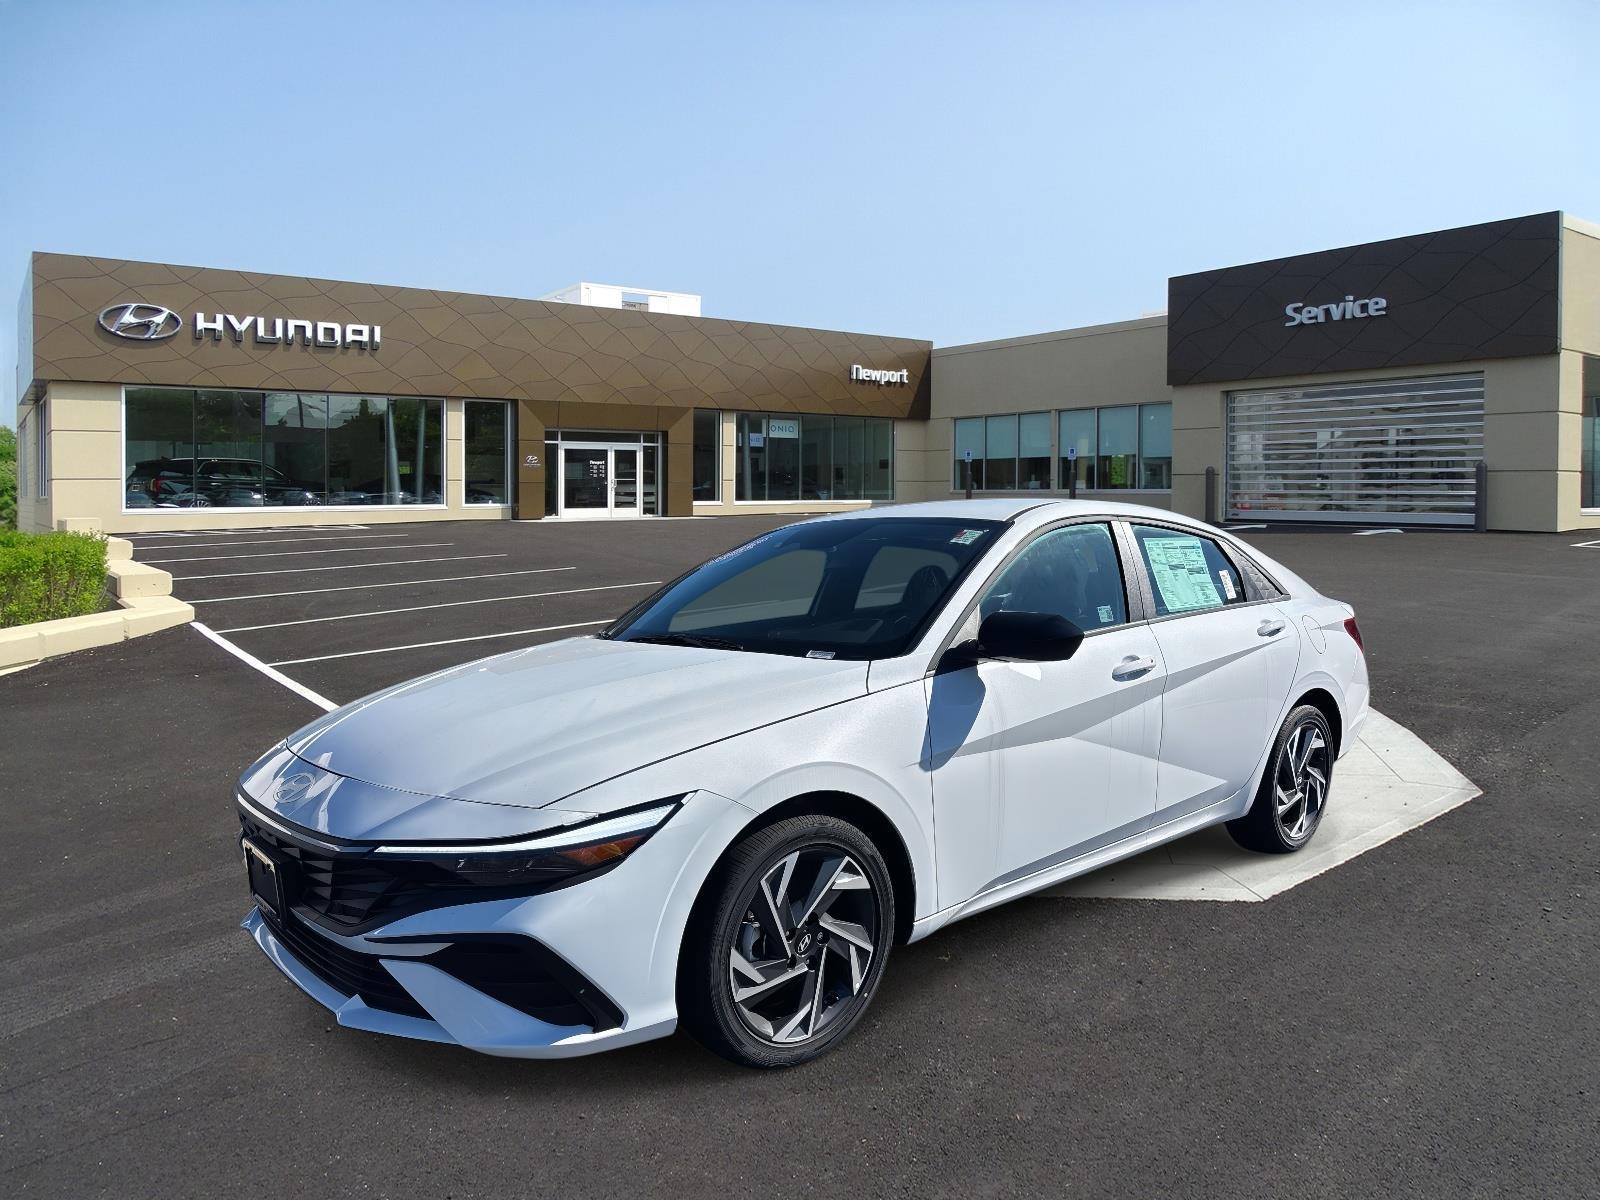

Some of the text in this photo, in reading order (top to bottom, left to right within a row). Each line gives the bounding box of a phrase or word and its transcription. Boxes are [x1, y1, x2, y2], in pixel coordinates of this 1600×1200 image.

[1285, 295, 1387, 327] Service
[194, 312, 382, 350] HYUNDAI
[850, 364, 909, 385] Newport
[769, 424, 795, 433] ONIQ
